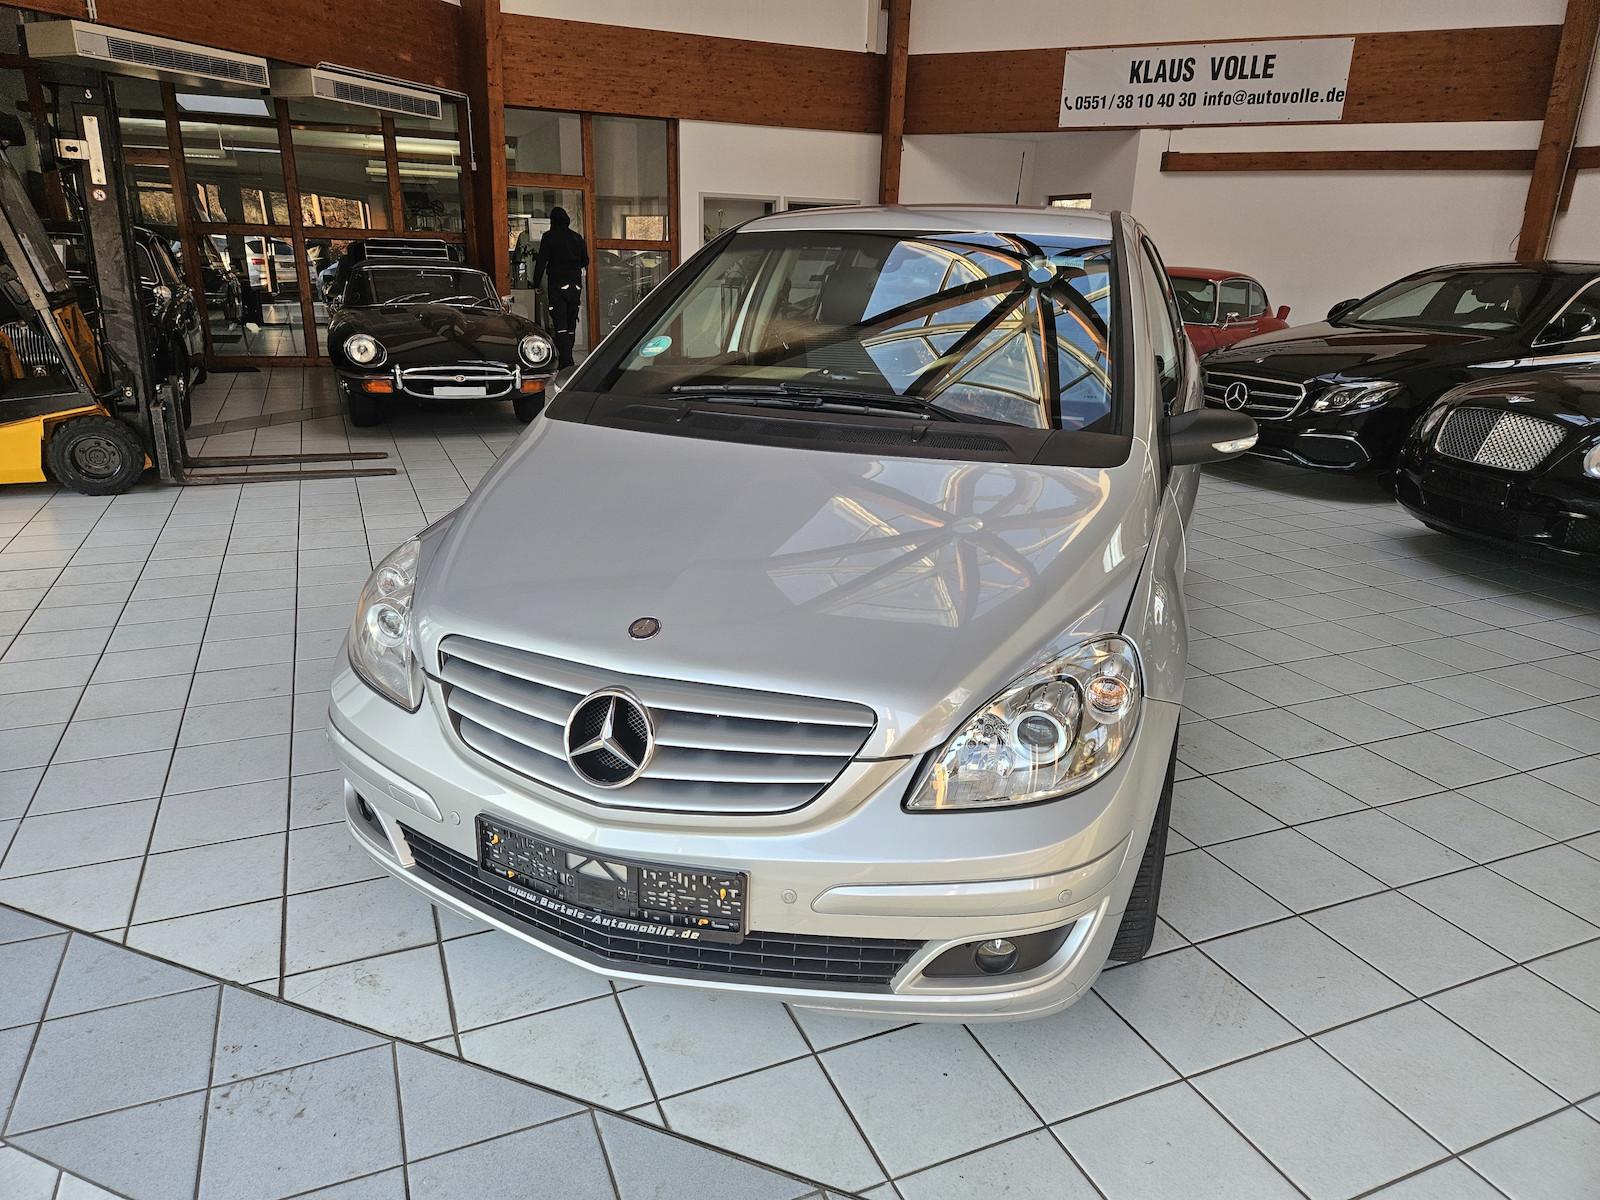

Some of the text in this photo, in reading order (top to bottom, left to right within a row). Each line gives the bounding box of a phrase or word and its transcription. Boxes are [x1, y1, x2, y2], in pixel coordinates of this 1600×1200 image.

[1129, 54, 1277, 84] KLAUS VOLLE
[1137, 93, 1154, 109] 10
[1156, 92, 1175, 108] 40
[1178, 92, 1197, 107] 30
[1202, 87, 1345, 107] info@autovolle.de
[507, 885, 700, 941] www.Bartels-Automobile.de
